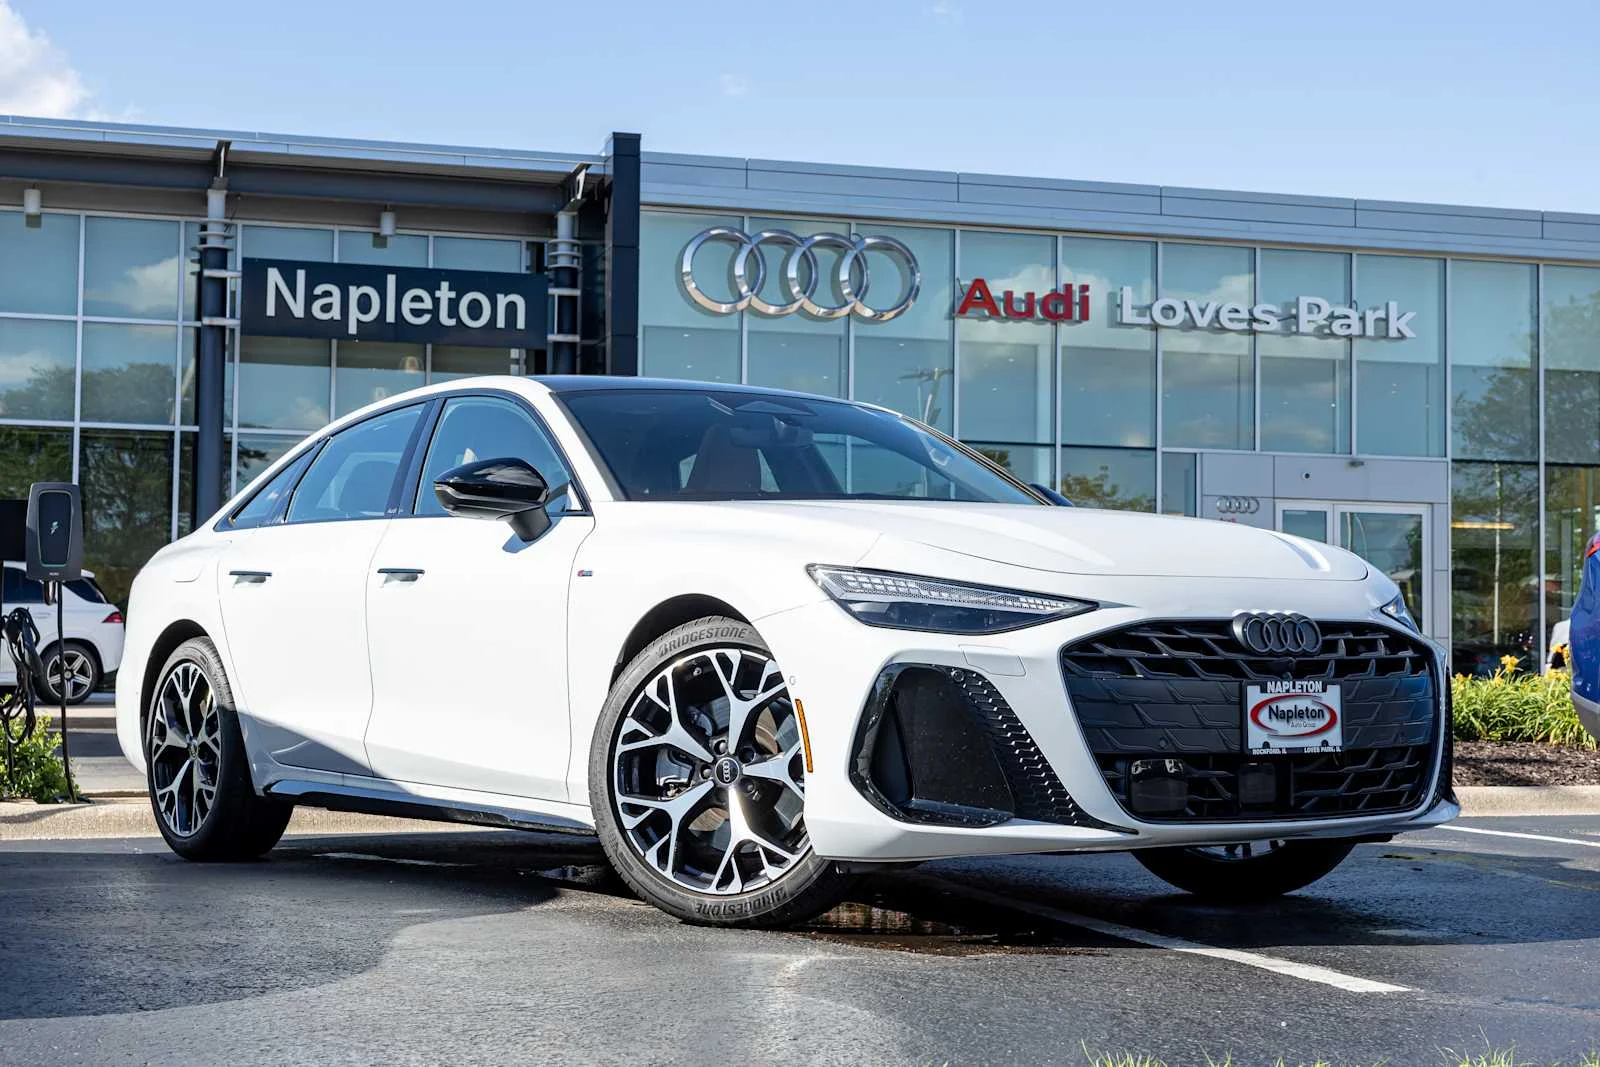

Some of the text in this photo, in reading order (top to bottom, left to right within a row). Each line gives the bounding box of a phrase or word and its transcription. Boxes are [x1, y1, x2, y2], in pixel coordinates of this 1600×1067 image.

[265, 267, 526, 335] Napleton
[957, 277, 1417, 338] Audi Loves Park
[659, 626, 748, 657] BRIDGESTONE
[1267, 681, 1322, 693] NAPLETON
[1268, 705, 1325, 723] Napleton
[695, 886, 788, 916] BRIDGESTONE
